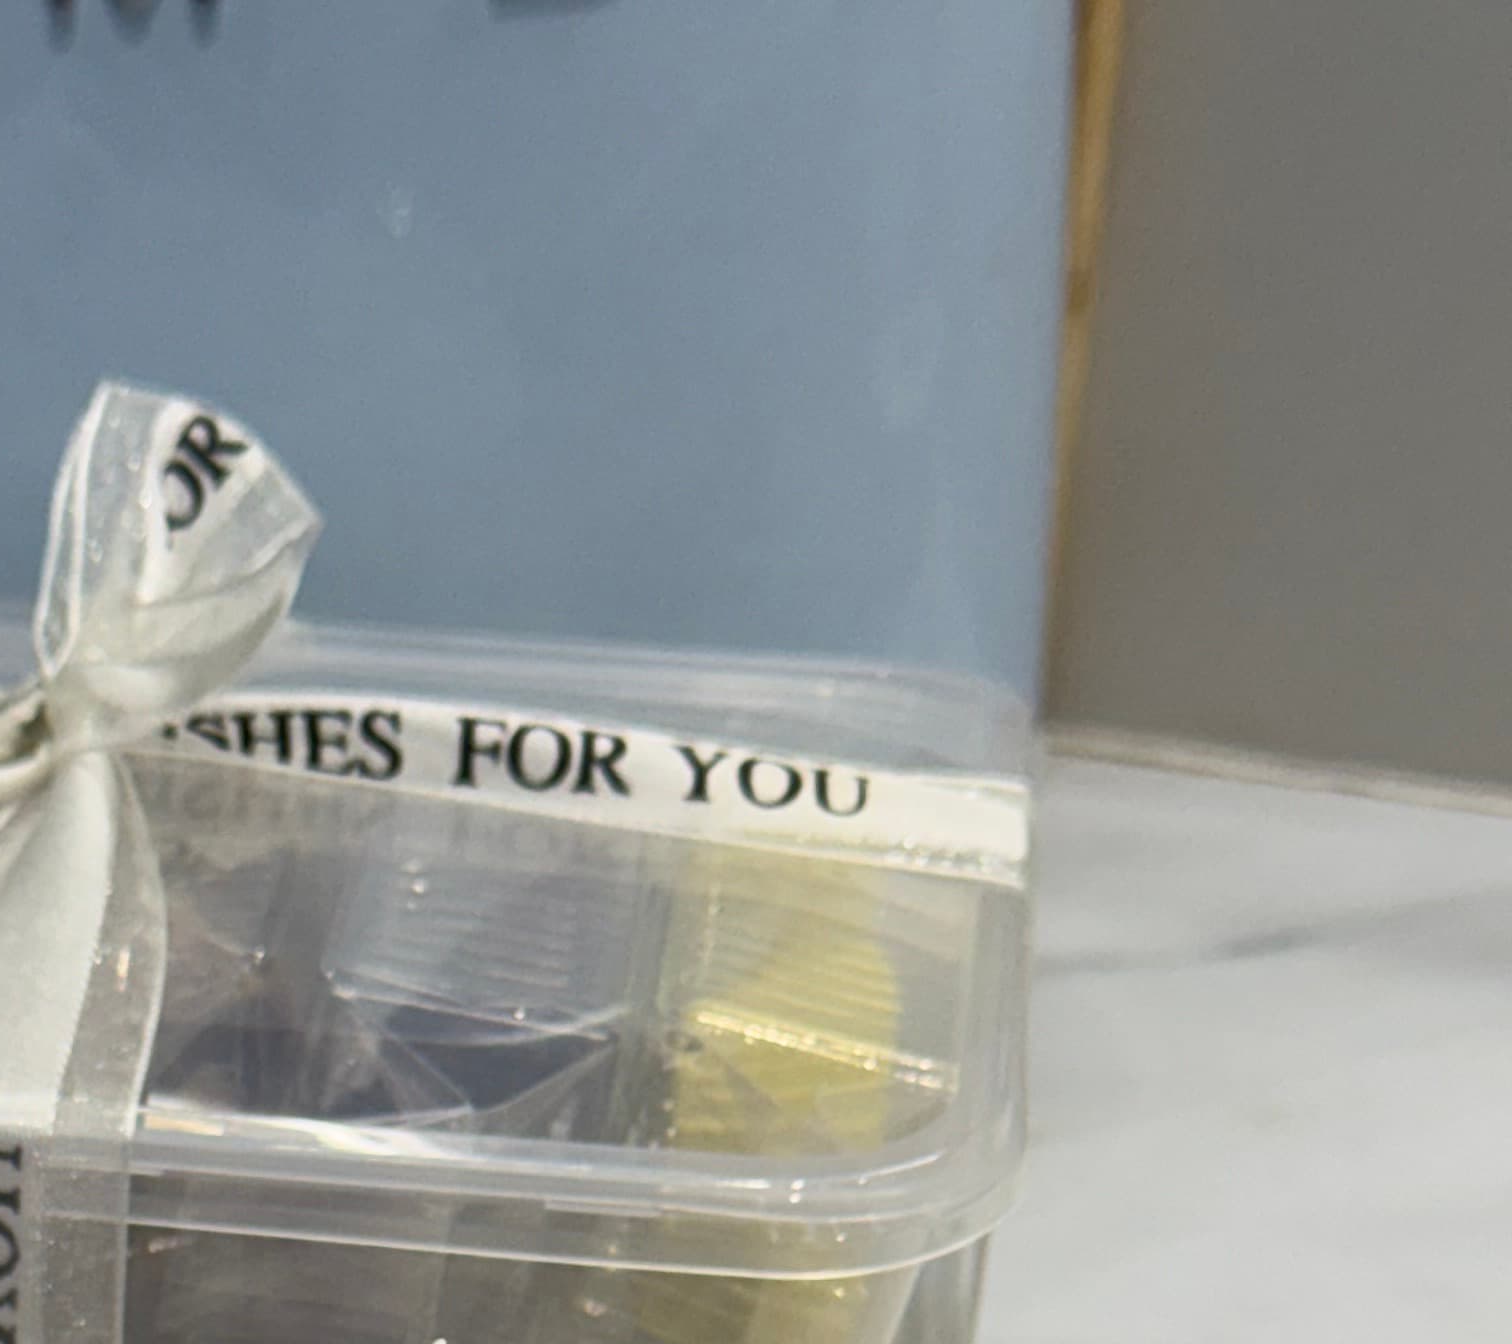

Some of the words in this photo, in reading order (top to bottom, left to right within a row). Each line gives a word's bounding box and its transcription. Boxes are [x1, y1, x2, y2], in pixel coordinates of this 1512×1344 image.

[162, 415, 249, 534] OR
[162, 708, 404, 782] SHES
[453, 715, 631, 797] FOR
[674, 743, 870, 817] YOU
